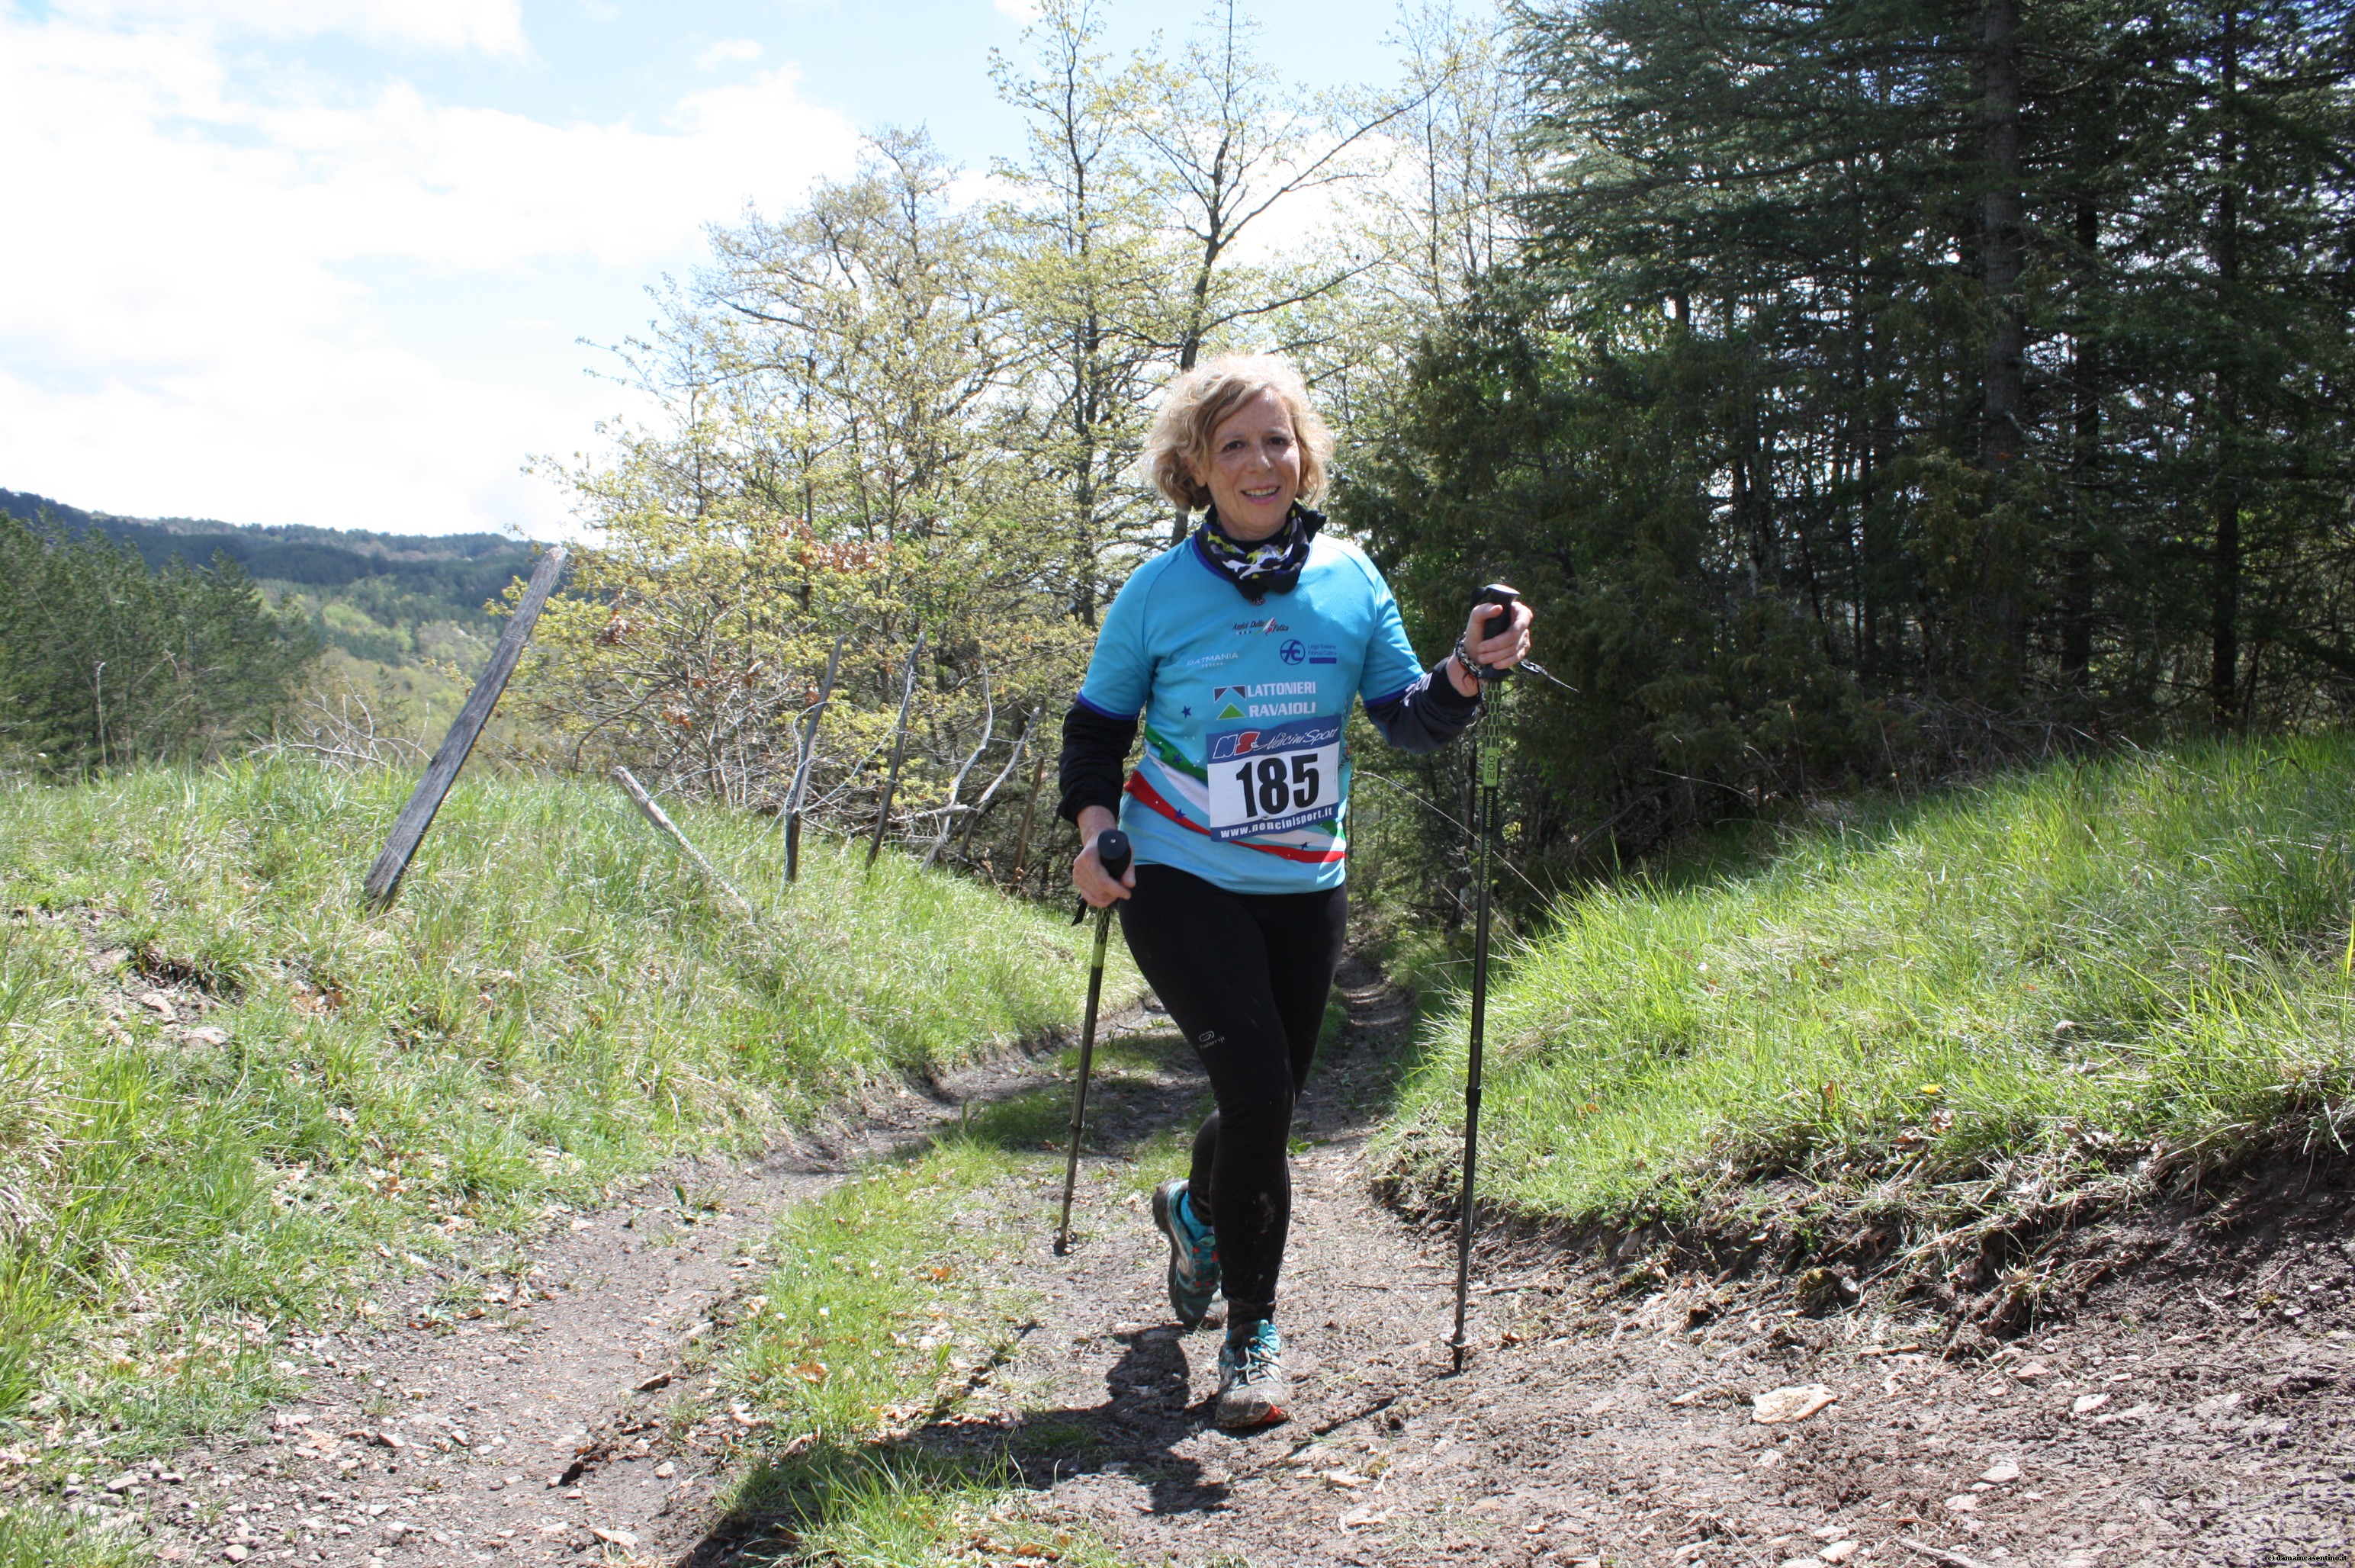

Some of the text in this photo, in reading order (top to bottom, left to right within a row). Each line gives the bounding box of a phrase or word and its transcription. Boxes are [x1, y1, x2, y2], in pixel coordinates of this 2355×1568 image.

[1248, 682, 1316, 697] LATTONIERI
[1248, 702, 1316, 718] RAVAIOLI
[1487, 755, 1496, 779] 200
[1235, 753, 1319, 818] 185
[1220, 807, 1332, 838] www.nencinisport.it
[1481, 839, 1491, 892] Quechua
